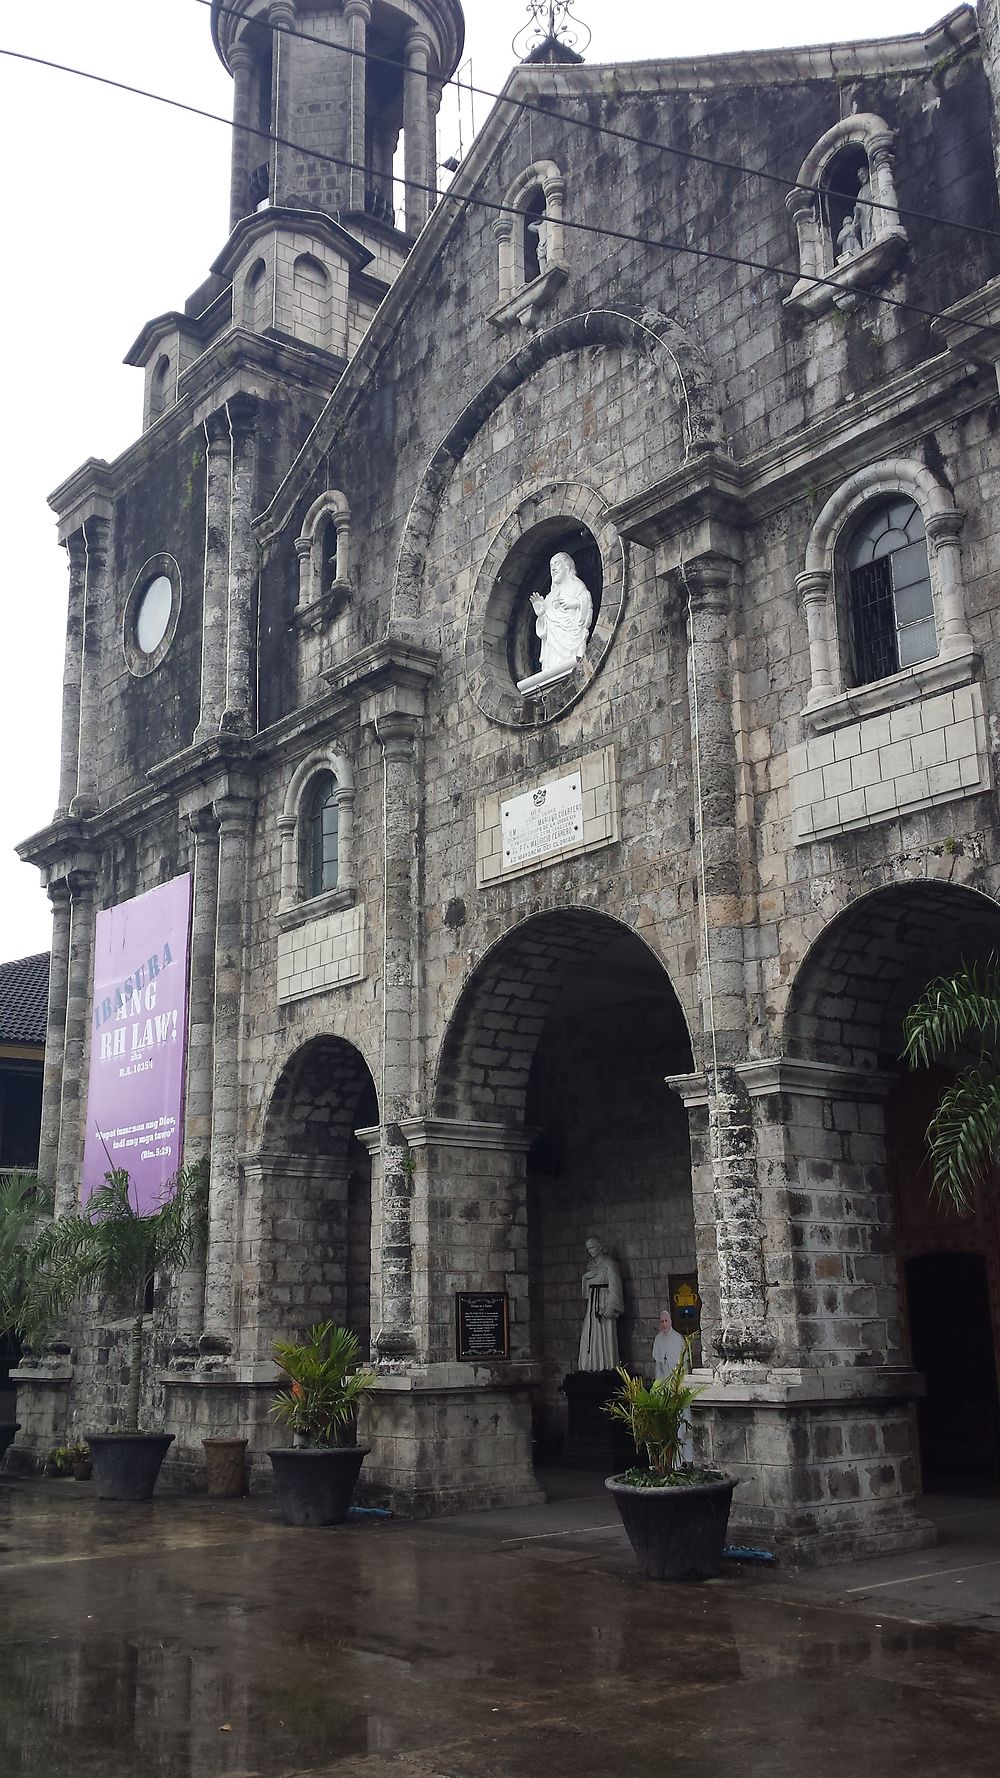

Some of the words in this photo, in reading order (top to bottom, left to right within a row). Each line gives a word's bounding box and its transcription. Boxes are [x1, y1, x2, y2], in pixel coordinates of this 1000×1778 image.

[95, 942, 173, 1030] IBASURA
[115, 981, 157, 1021] ANG
[99, 1026, 127, 1060] RH
[131, 1009, 178, 1051] LAW!
[126, 1137, 139, 1147] ang
[145, 1119, 159, 1131] ang
